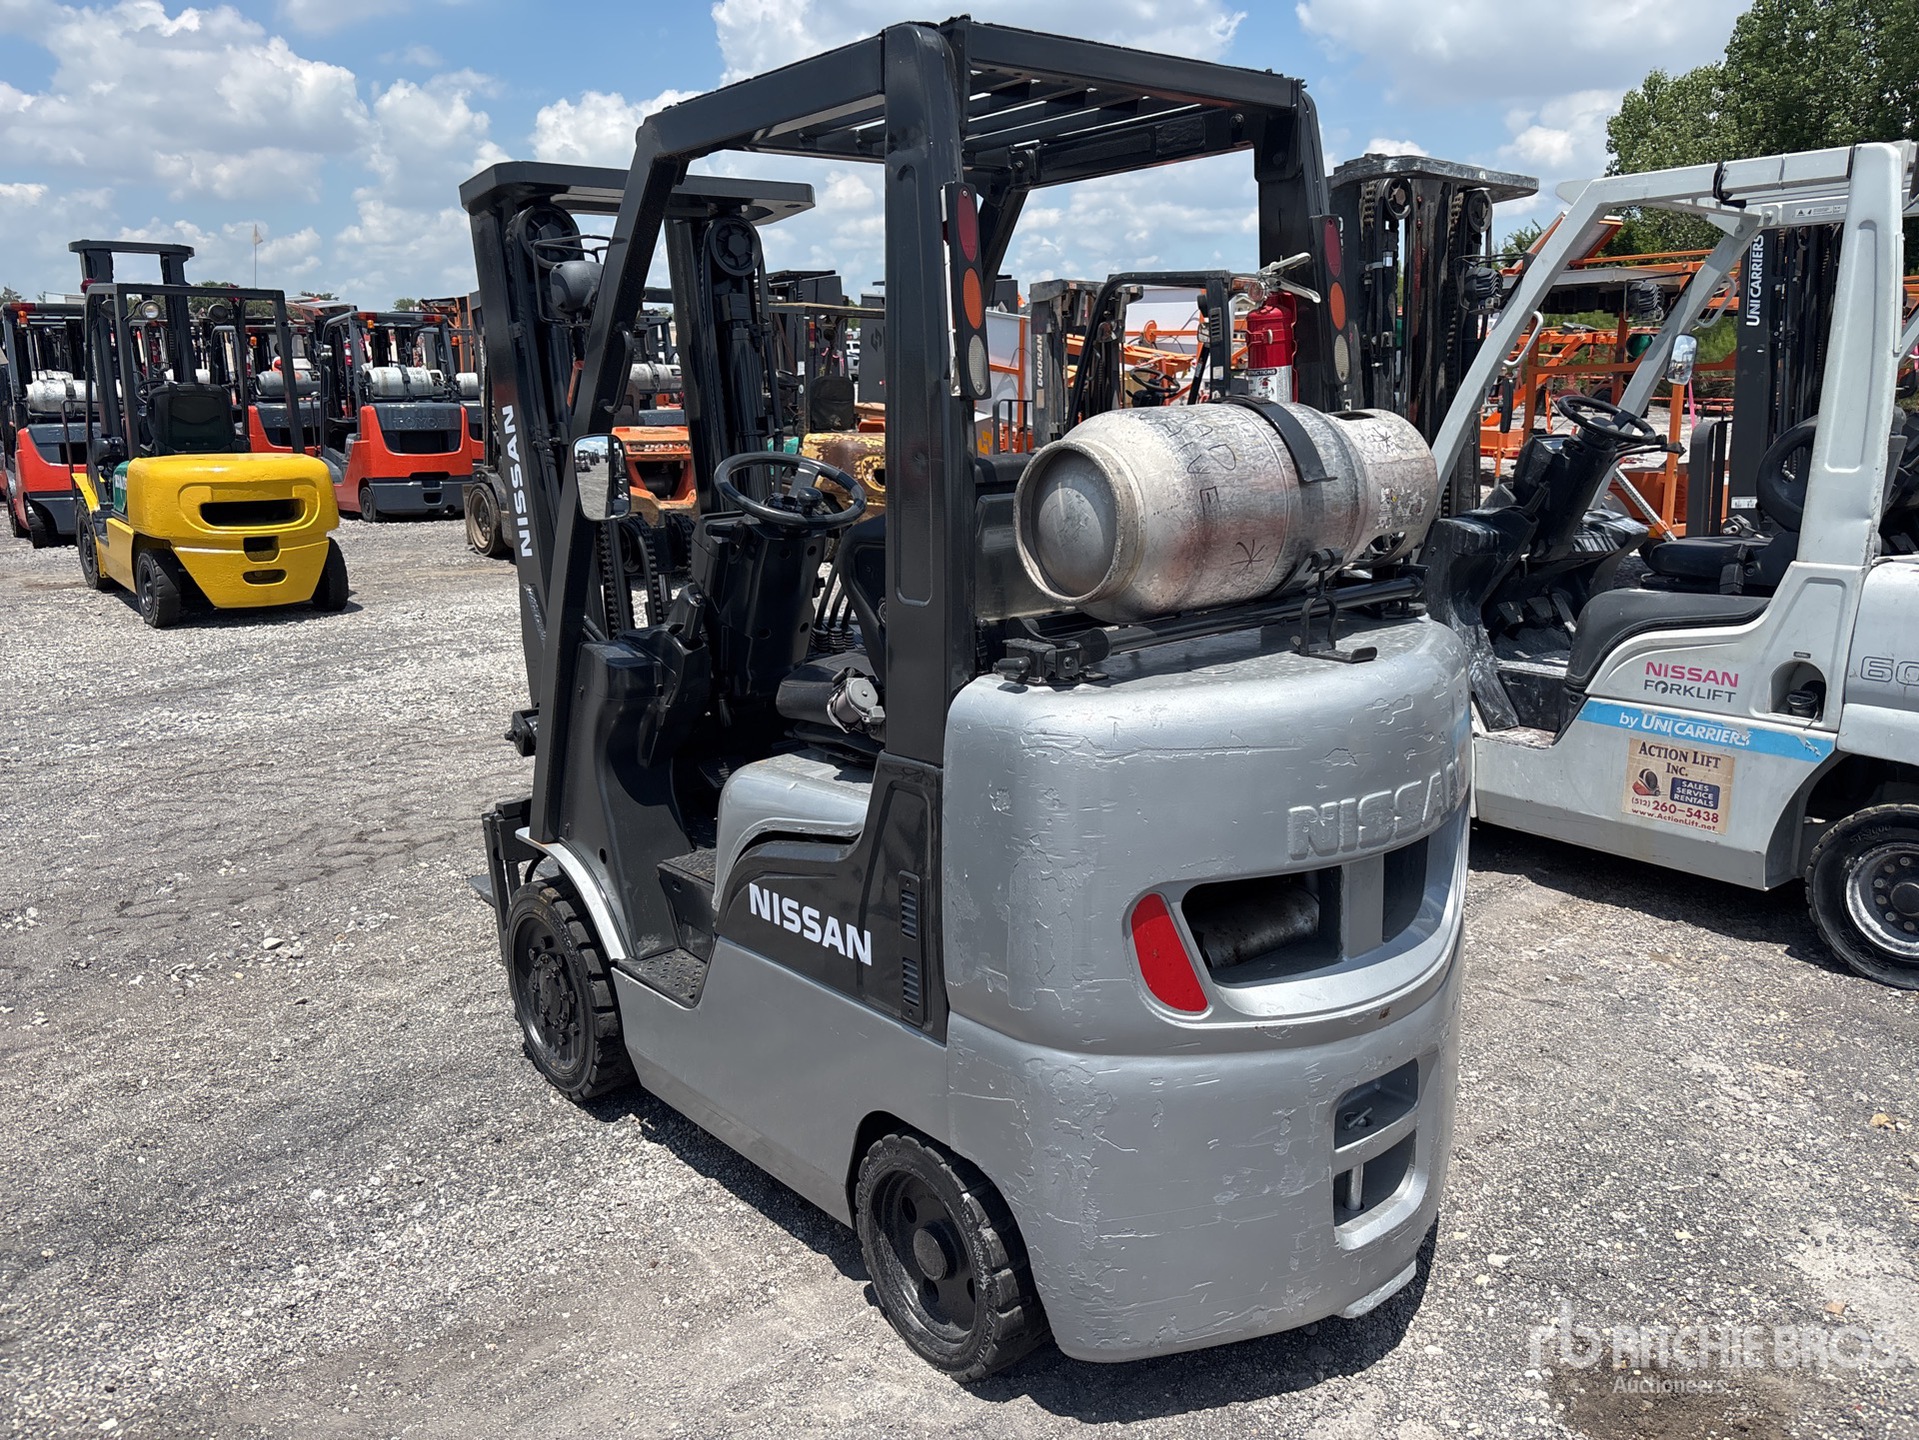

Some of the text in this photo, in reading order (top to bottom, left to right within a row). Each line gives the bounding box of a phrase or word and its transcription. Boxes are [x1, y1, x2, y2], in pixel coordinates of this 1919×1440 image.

[502, 405, 532, 557] NISSAN
[1646, 661, 1739, 688] NISSAN
[1644, 680, 1736, 703] FORKLIFT
[1619, 711, 1638, 728] by
[1638, 741, 1721, 769] ACTION LIFT
[1666, 762, 1688, 777] INC.
[1676, 787, 1714, 800] SERVICE
[1682, 780, 1709, 792] SALES
[1631, 797, 1719, 824] (512) 260-5438
[1673, 793, 1714, 807] RENTALS
[1632, 808, 1716, 831] www.ActionLift.net
[749, 882, 872, 966] NISSAN
